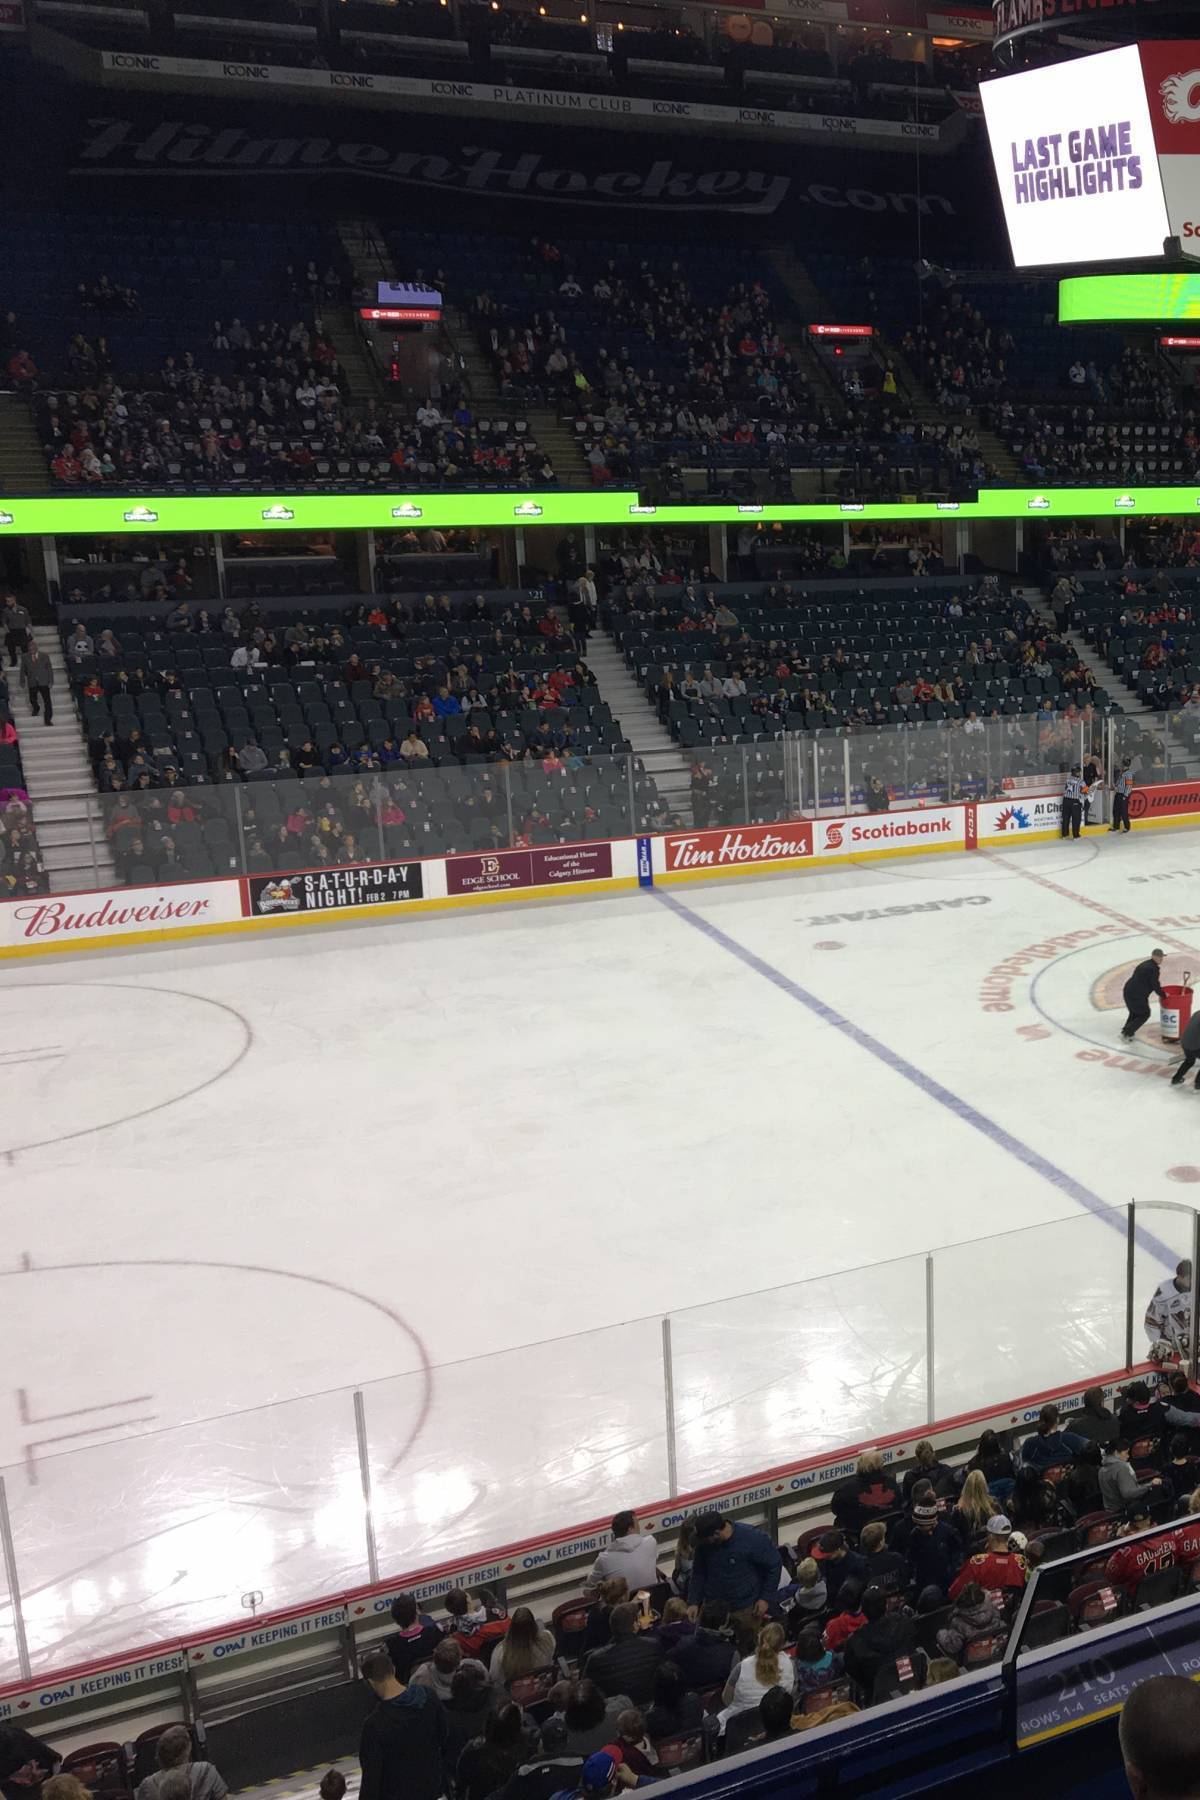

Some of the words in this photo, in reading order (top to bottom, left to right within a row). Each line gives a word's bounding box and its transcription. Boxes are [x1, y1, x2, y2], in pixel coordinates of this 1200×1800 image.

[111, 54, 160, 70] ICONIC
[223, 64, 269, 79] ICONIC
[330, 73, 374, 88] ICONIC
[431, 82, 473, 97] ICONIC
[494, 87, 582, 108] PLATINUM
[588, 95, 632, 112] CLUB
[652, 102, 690, 116] ICONIC
[1011, 133, 1062, 173] LAST
[1069, 121, 1132, 168] GAME
[1014, 156, 1143, 205] HIGHLIGHTS
[1034, 803, 1045, 815] A1
[851, 818, 951, 842] Scotiabank
[544, 853, 579, 862] Educational
[580, 851, 598, 859] Home
[670, 838, 714, 868] Tim
[719, 832, 806, 864] Hortons
[304, 866, 409, 892] S-A-T-U-R-D-A-Y
[462, 877, 485, 886] EDGE
[487, 873, 520, 884] SCHOOL
[548, 870, 572, 879] Calgary
[573, 867, 596, 875] Hitmen
[306, 887, 363, 909] NIGHT!
[366, 893, 379, 903] FEB
[380, 892, 387, 902] 2
[392, 891, 397, 900] 7
[398, 890, 410, 899] PM
[14, 899, 210, 938] Budweiser
[790, 1473, 816, 1490] OPA!
[819, 1464, 854, 1482] KEEPING
[662, 1510, 689, 1528] OPA!
[732, 1496, 741, 1507] IT
[743, 1488, 771, 1503] FRESH
[522, 1551, 551, 1569] OPA!
[555, 1537, 597, 1560] KEEPING
[599, 1533, 610, 1546] IT
[408, 1580, 452, 1600] KEEPING
[455, 1576, 465, 1589] IT
[468, 1566, 500, 1586] FRESH
[213, 1637, 247, 1659] OPA!
[251, 1624, 298, 1647] KEEPING
[300, 1620, 311, 1633] IT
[39, 1685, 76, 1707] OPA!
[80, 1670, 132, 1696] KEEPING
[134, 1666, 147, 1681] IT
[1047, 1656, 1116, 1702] 210
[1020, 1710, 1062, 1734] ROWS
[1062, 1702, 1086, 1718] 1-4
[1094, 1683, 1131, 1706] SEATS
